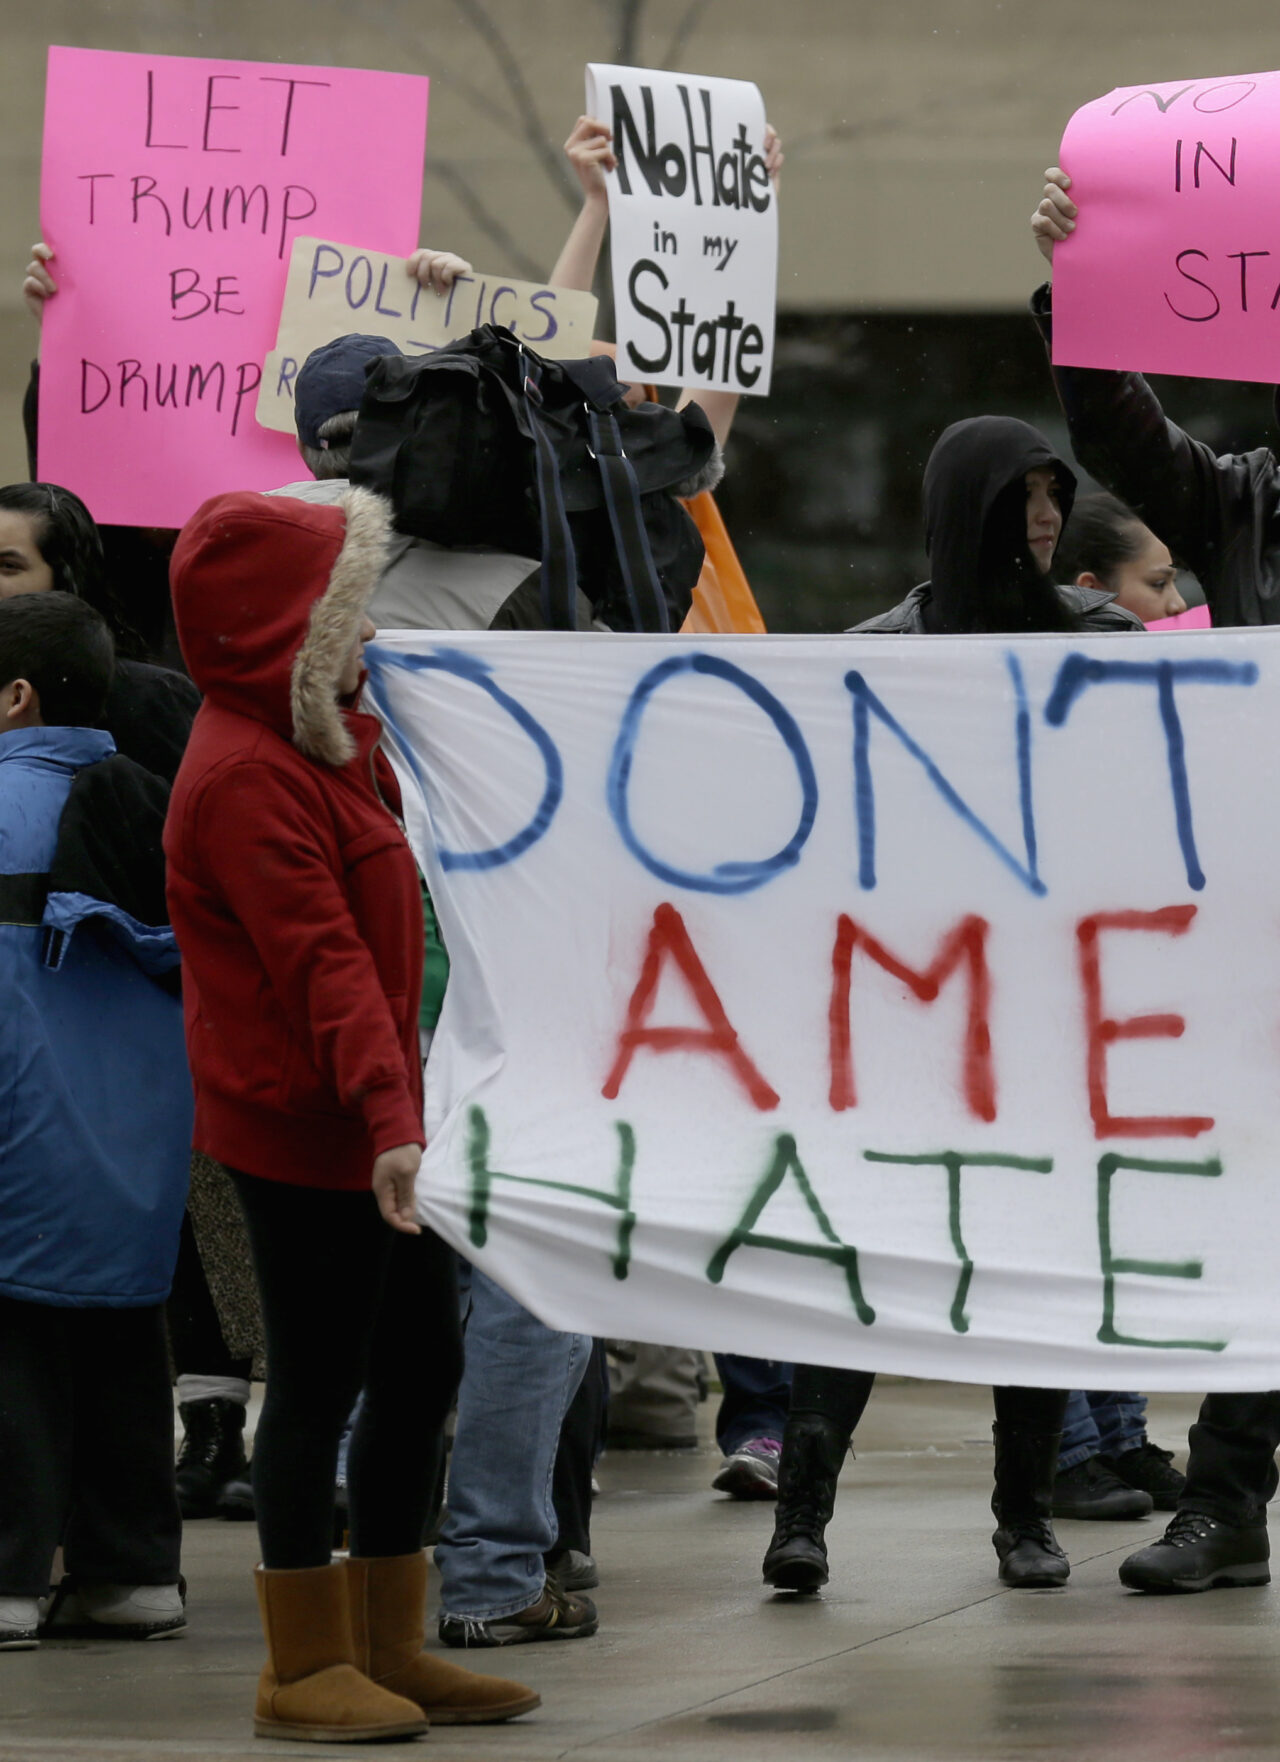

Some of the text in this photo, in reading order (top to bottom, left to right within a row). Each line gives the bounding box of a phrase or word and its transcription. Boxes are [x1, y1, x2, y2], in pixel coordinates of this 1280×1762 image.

[145, 70, 330, 156] LET
[1111, 81, 1256, 116] NO
[1174, 137, 1236, 193] IN
[653, 221, 738, 271] in my
[169, 268, 245, 320] BE
[626, 258, 764, 388] State
[363, 644, 1260, 898] DON'T
[467, 1104, 1228, 1352] HATE
